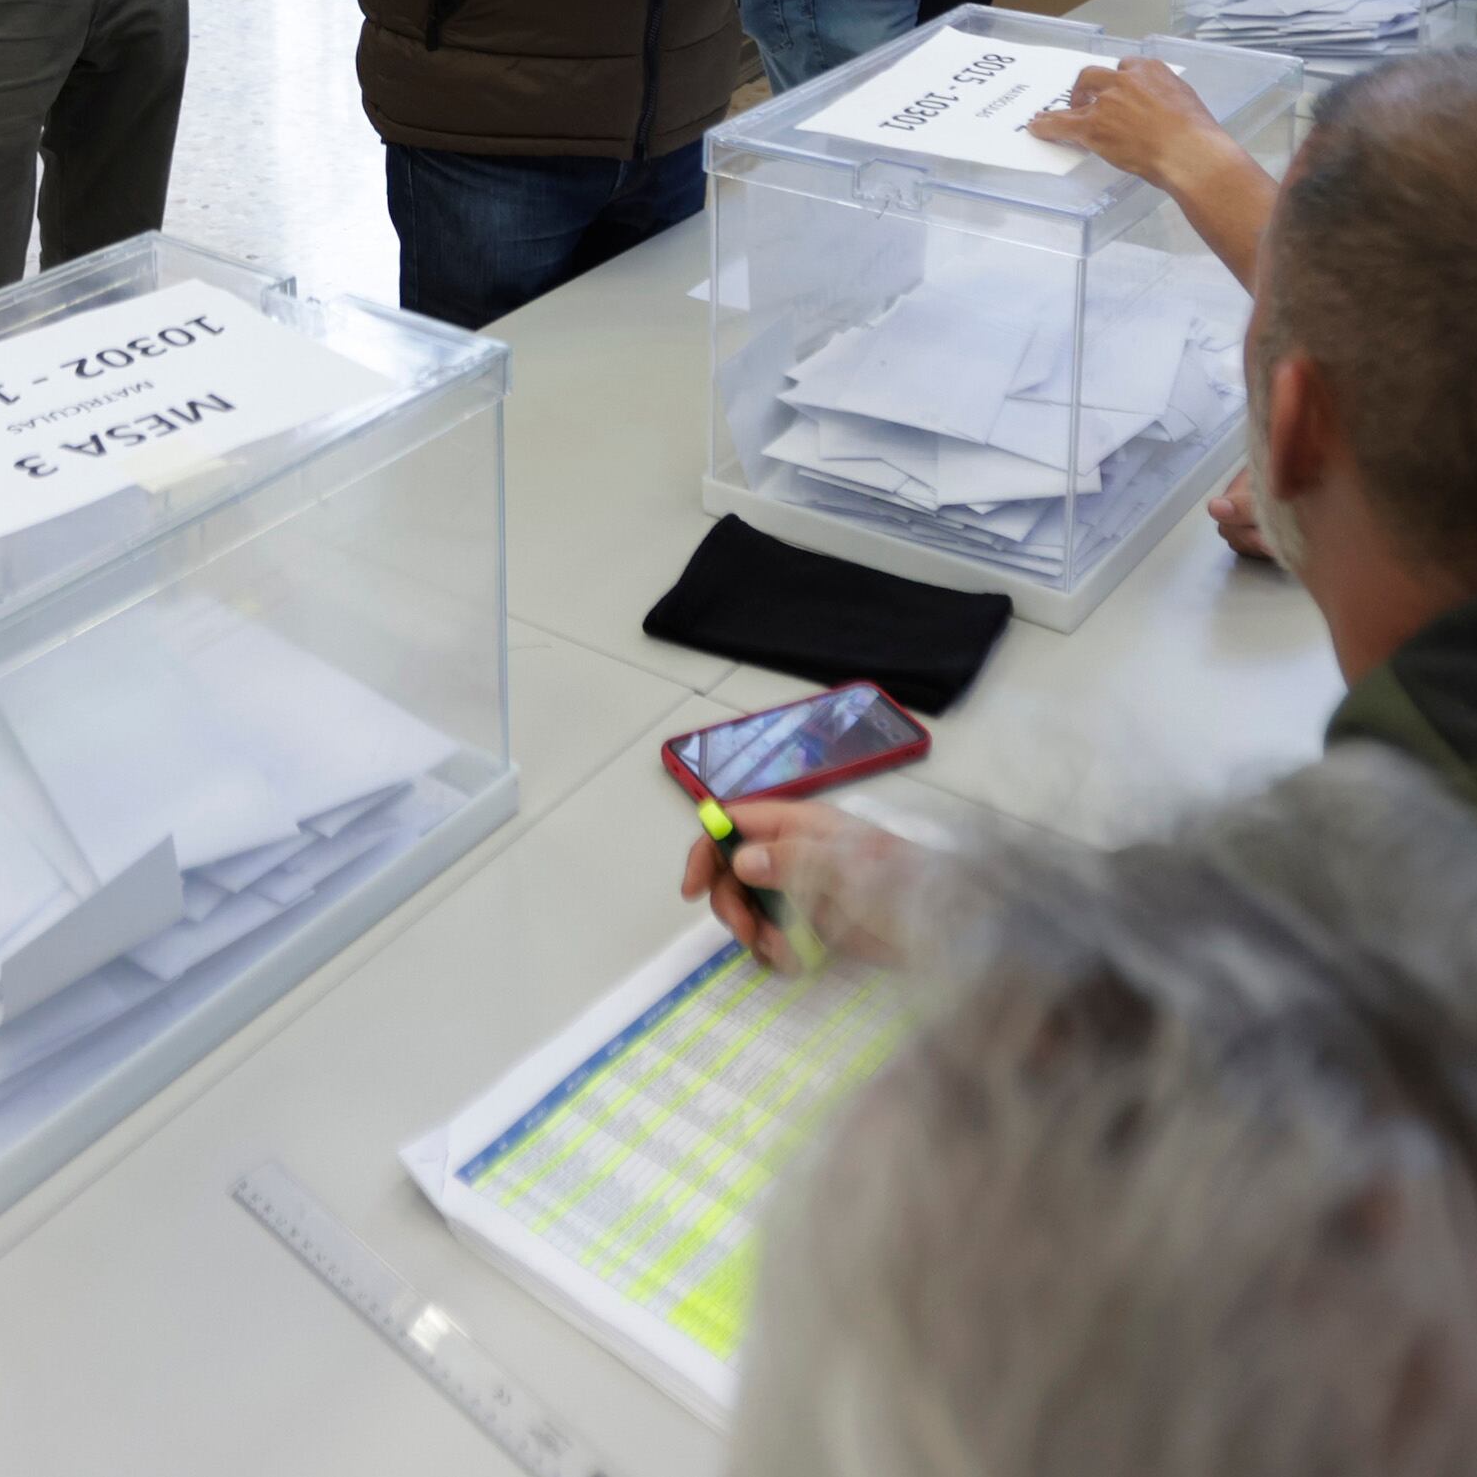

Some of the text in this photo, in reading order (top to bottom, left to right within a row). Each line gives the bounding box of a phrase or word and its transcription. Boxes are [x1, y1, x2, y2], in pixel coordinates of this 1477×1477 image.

[953, 53, 1016, 85] 8015
[878, 92, 960, 131] 10301
[60, 315, 225, 379] 10302
[31, 377, 49, 385] -
[6, 379, 154, 435] MATRÍCULAS
[13, 392, 236, 478] MESA 3
